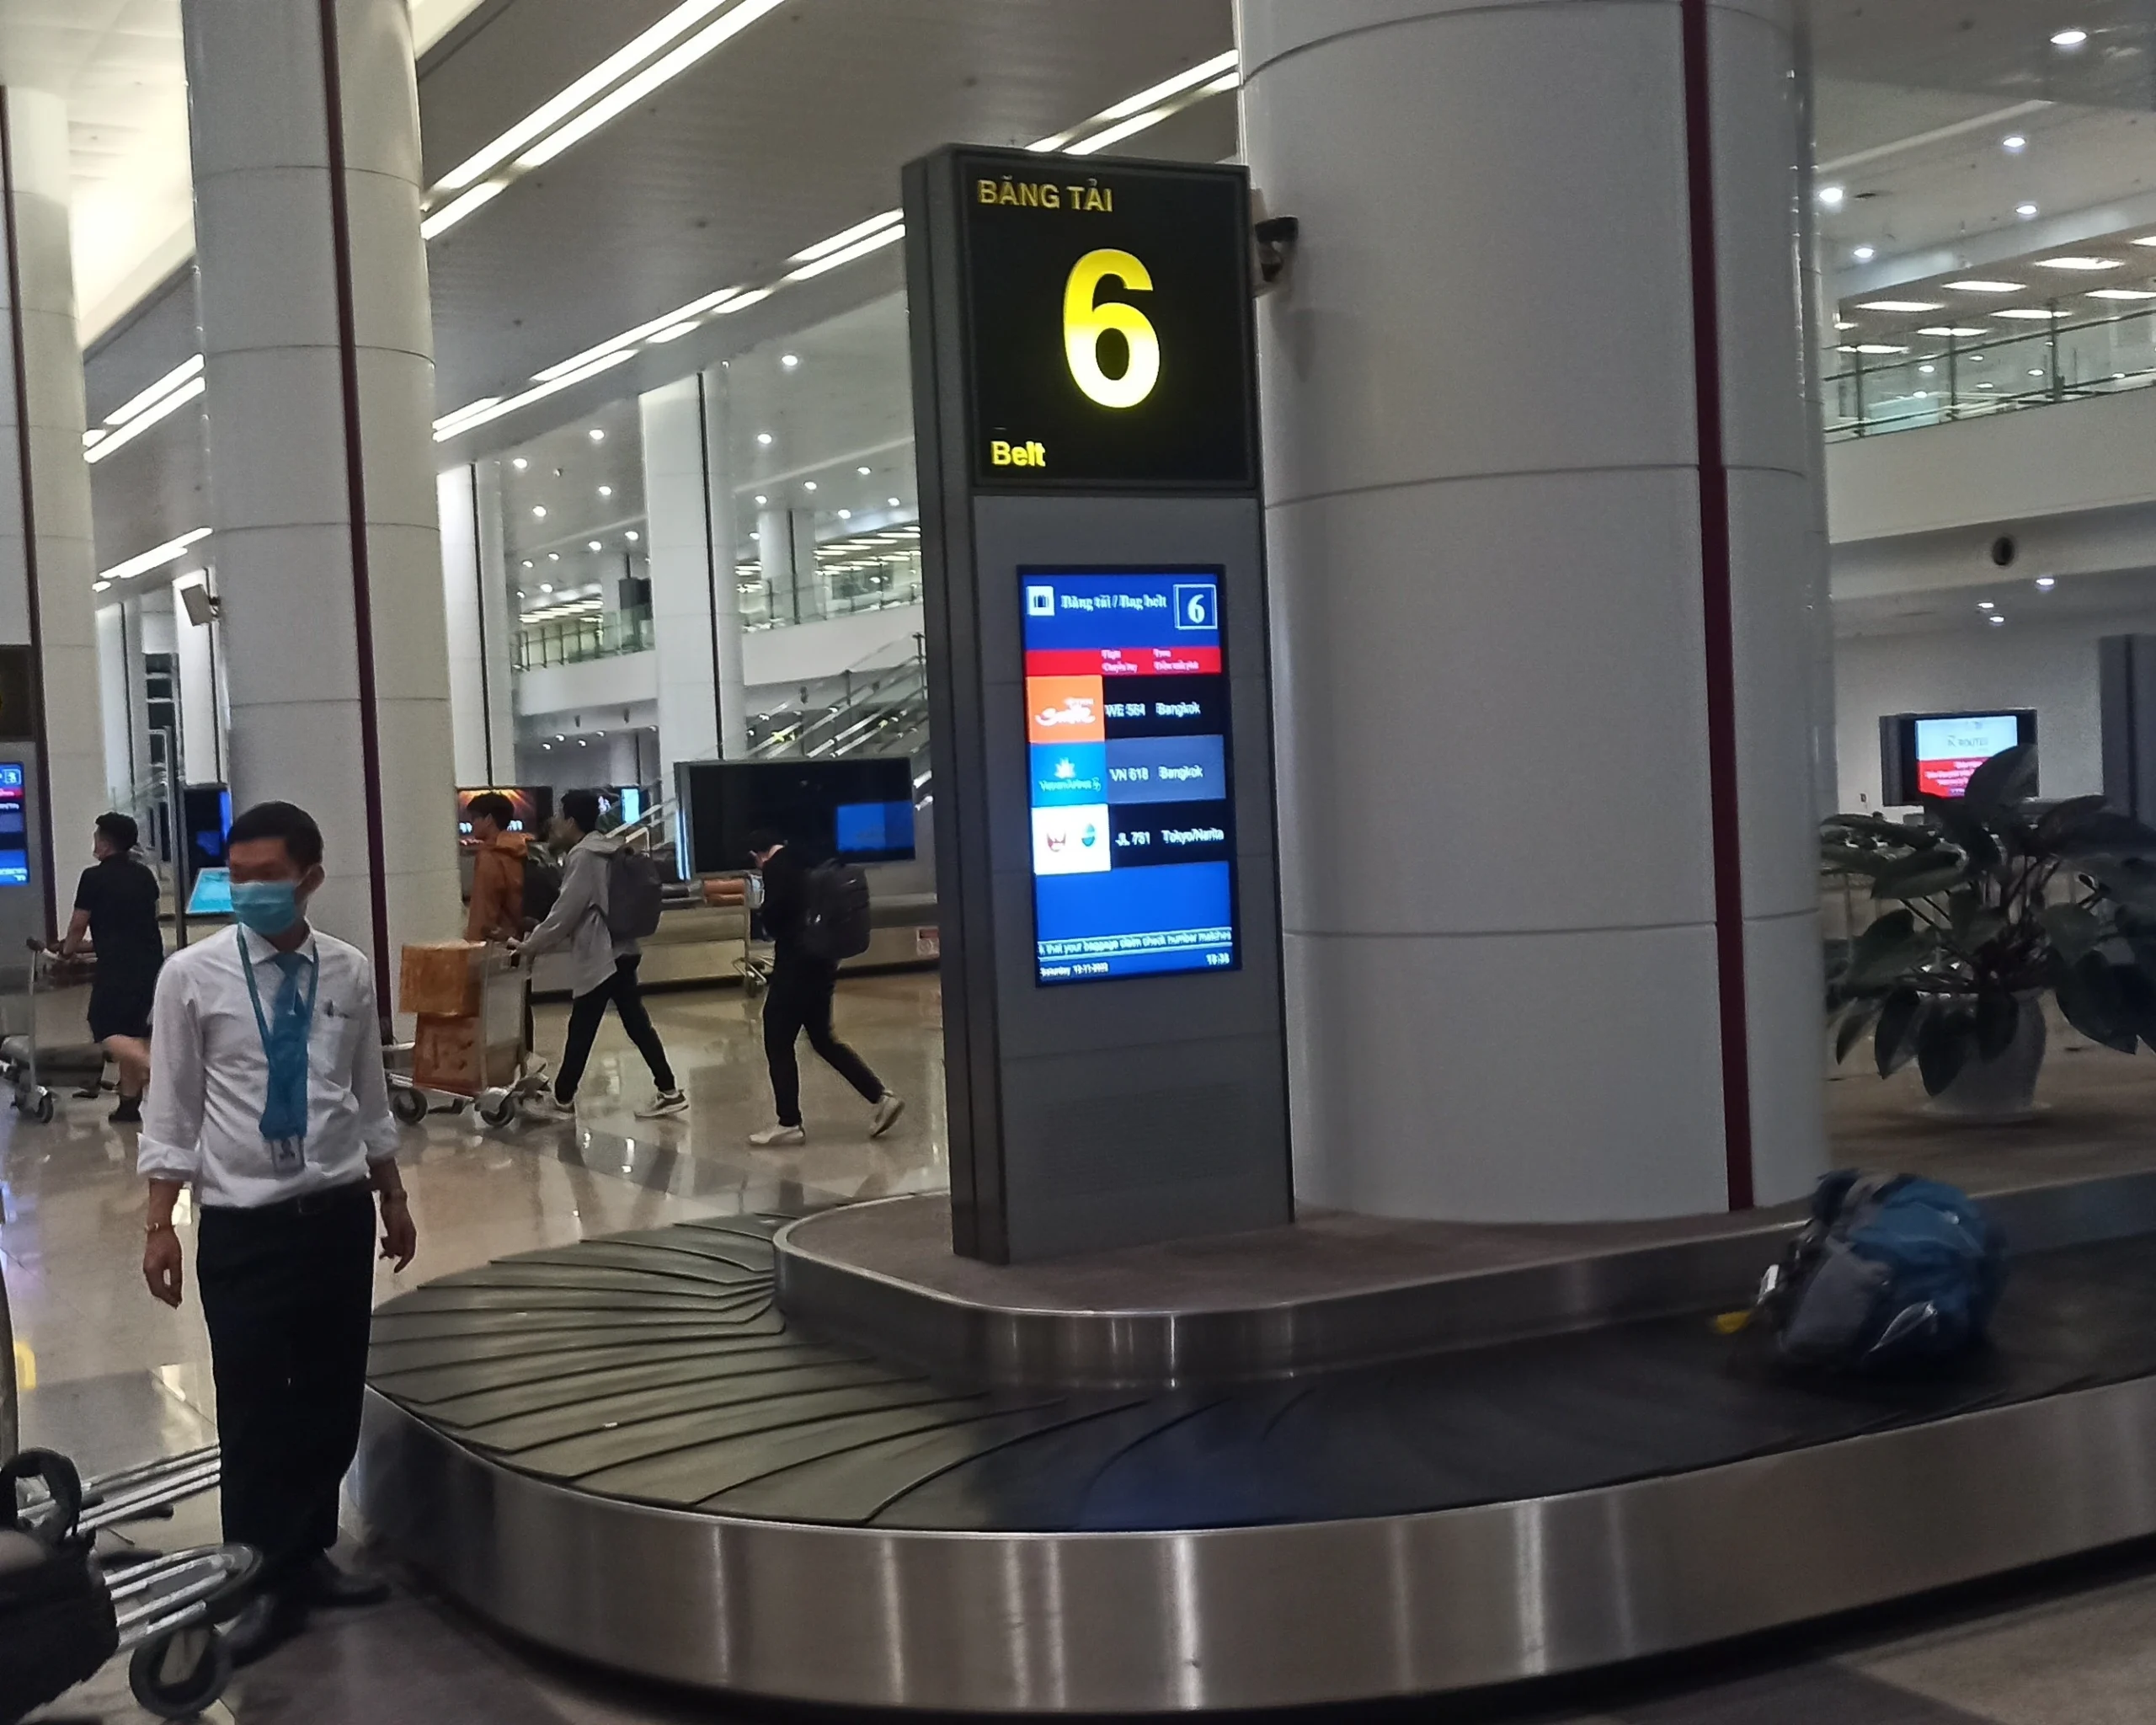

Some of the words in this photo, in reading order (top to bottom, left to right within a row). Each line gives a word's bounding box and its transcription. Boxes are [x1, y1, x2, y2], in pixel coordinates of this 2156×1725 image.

[978, 175, 1060, 209] BĂNG
[1067, 178, 1113, 212] TẢI
[1063, 248, 1161, 409] 6
[990, 441, 1046, 467] Belt
[1187, 595, 1205, 623] 6
[1155, 702, 1201, 718] Bangkok
[1109, 769, 1127, 782] VN
[1158, 766, 1203, 782] Bangkok
